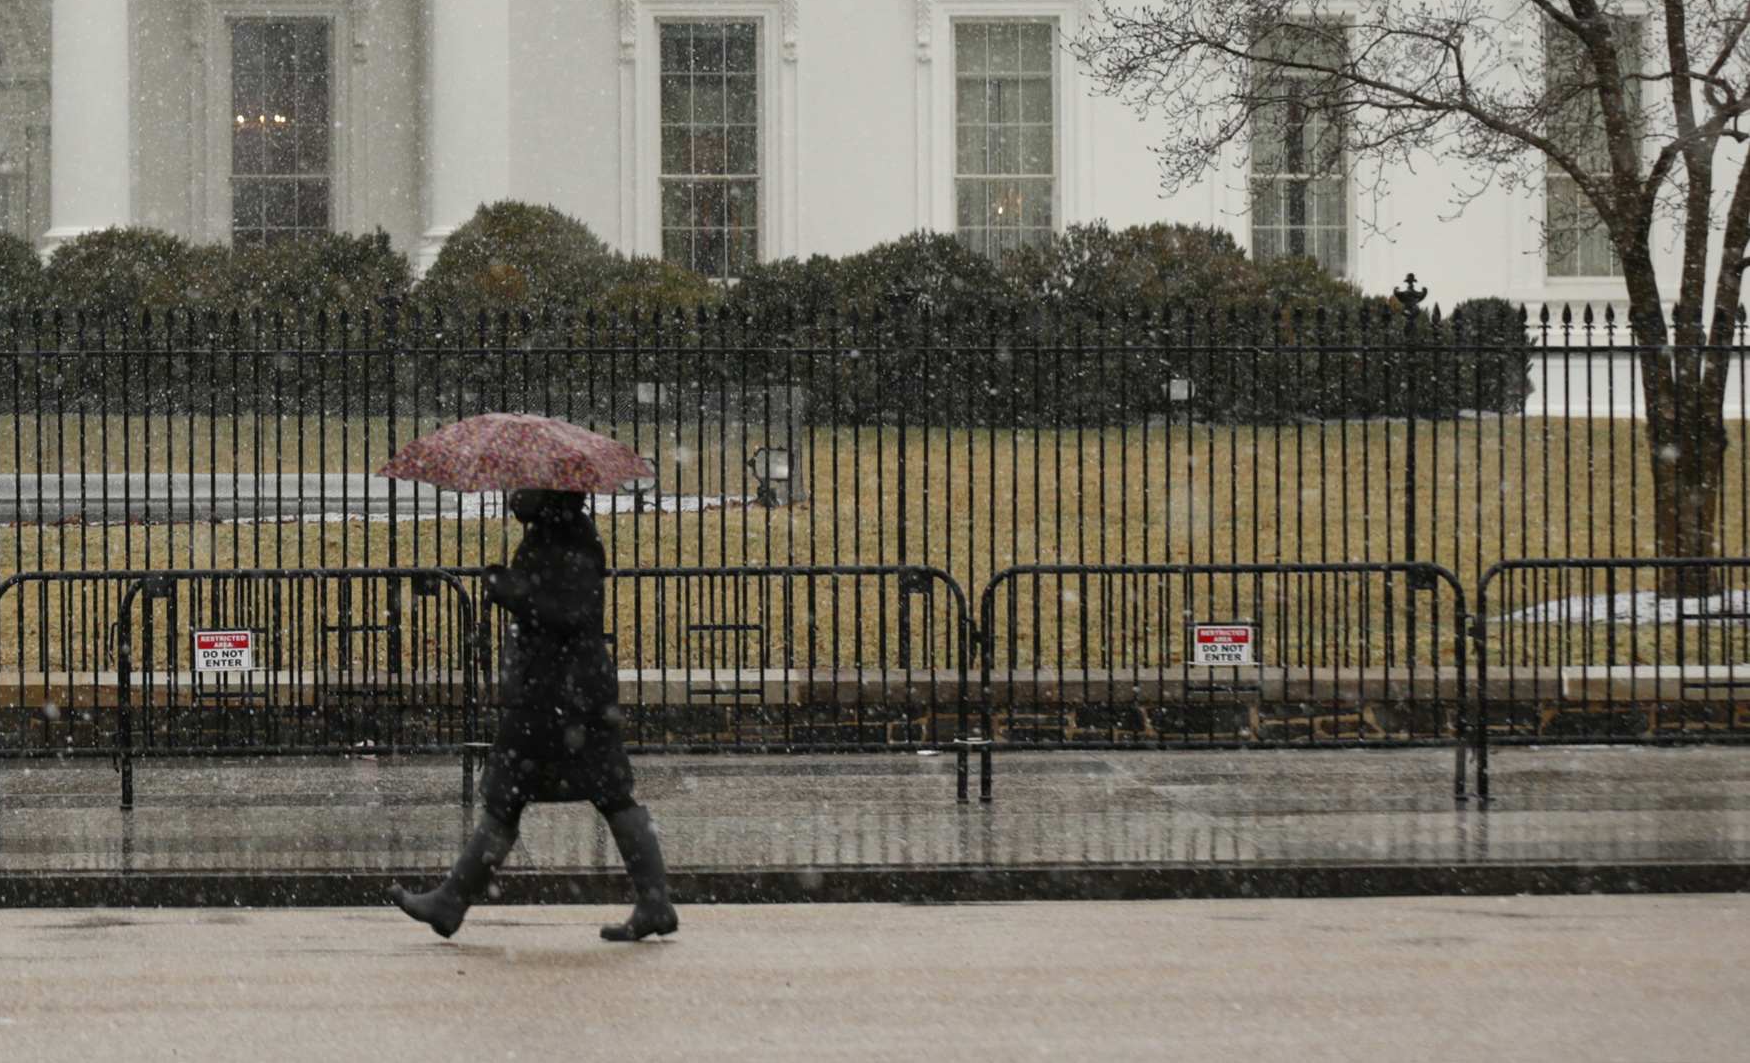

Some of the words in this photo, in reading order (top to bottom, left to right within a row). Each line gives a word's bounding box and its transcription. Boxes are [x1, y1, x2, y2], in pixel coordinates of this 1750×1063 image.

[1202, 644, 1218, 652] DO
[1221, 644, 1243, 652] NOT
[203, 650, 218, 658] DO
[1205, 653, 1241, 661] ENTER
[206, 659, 242, 667] ENTER
